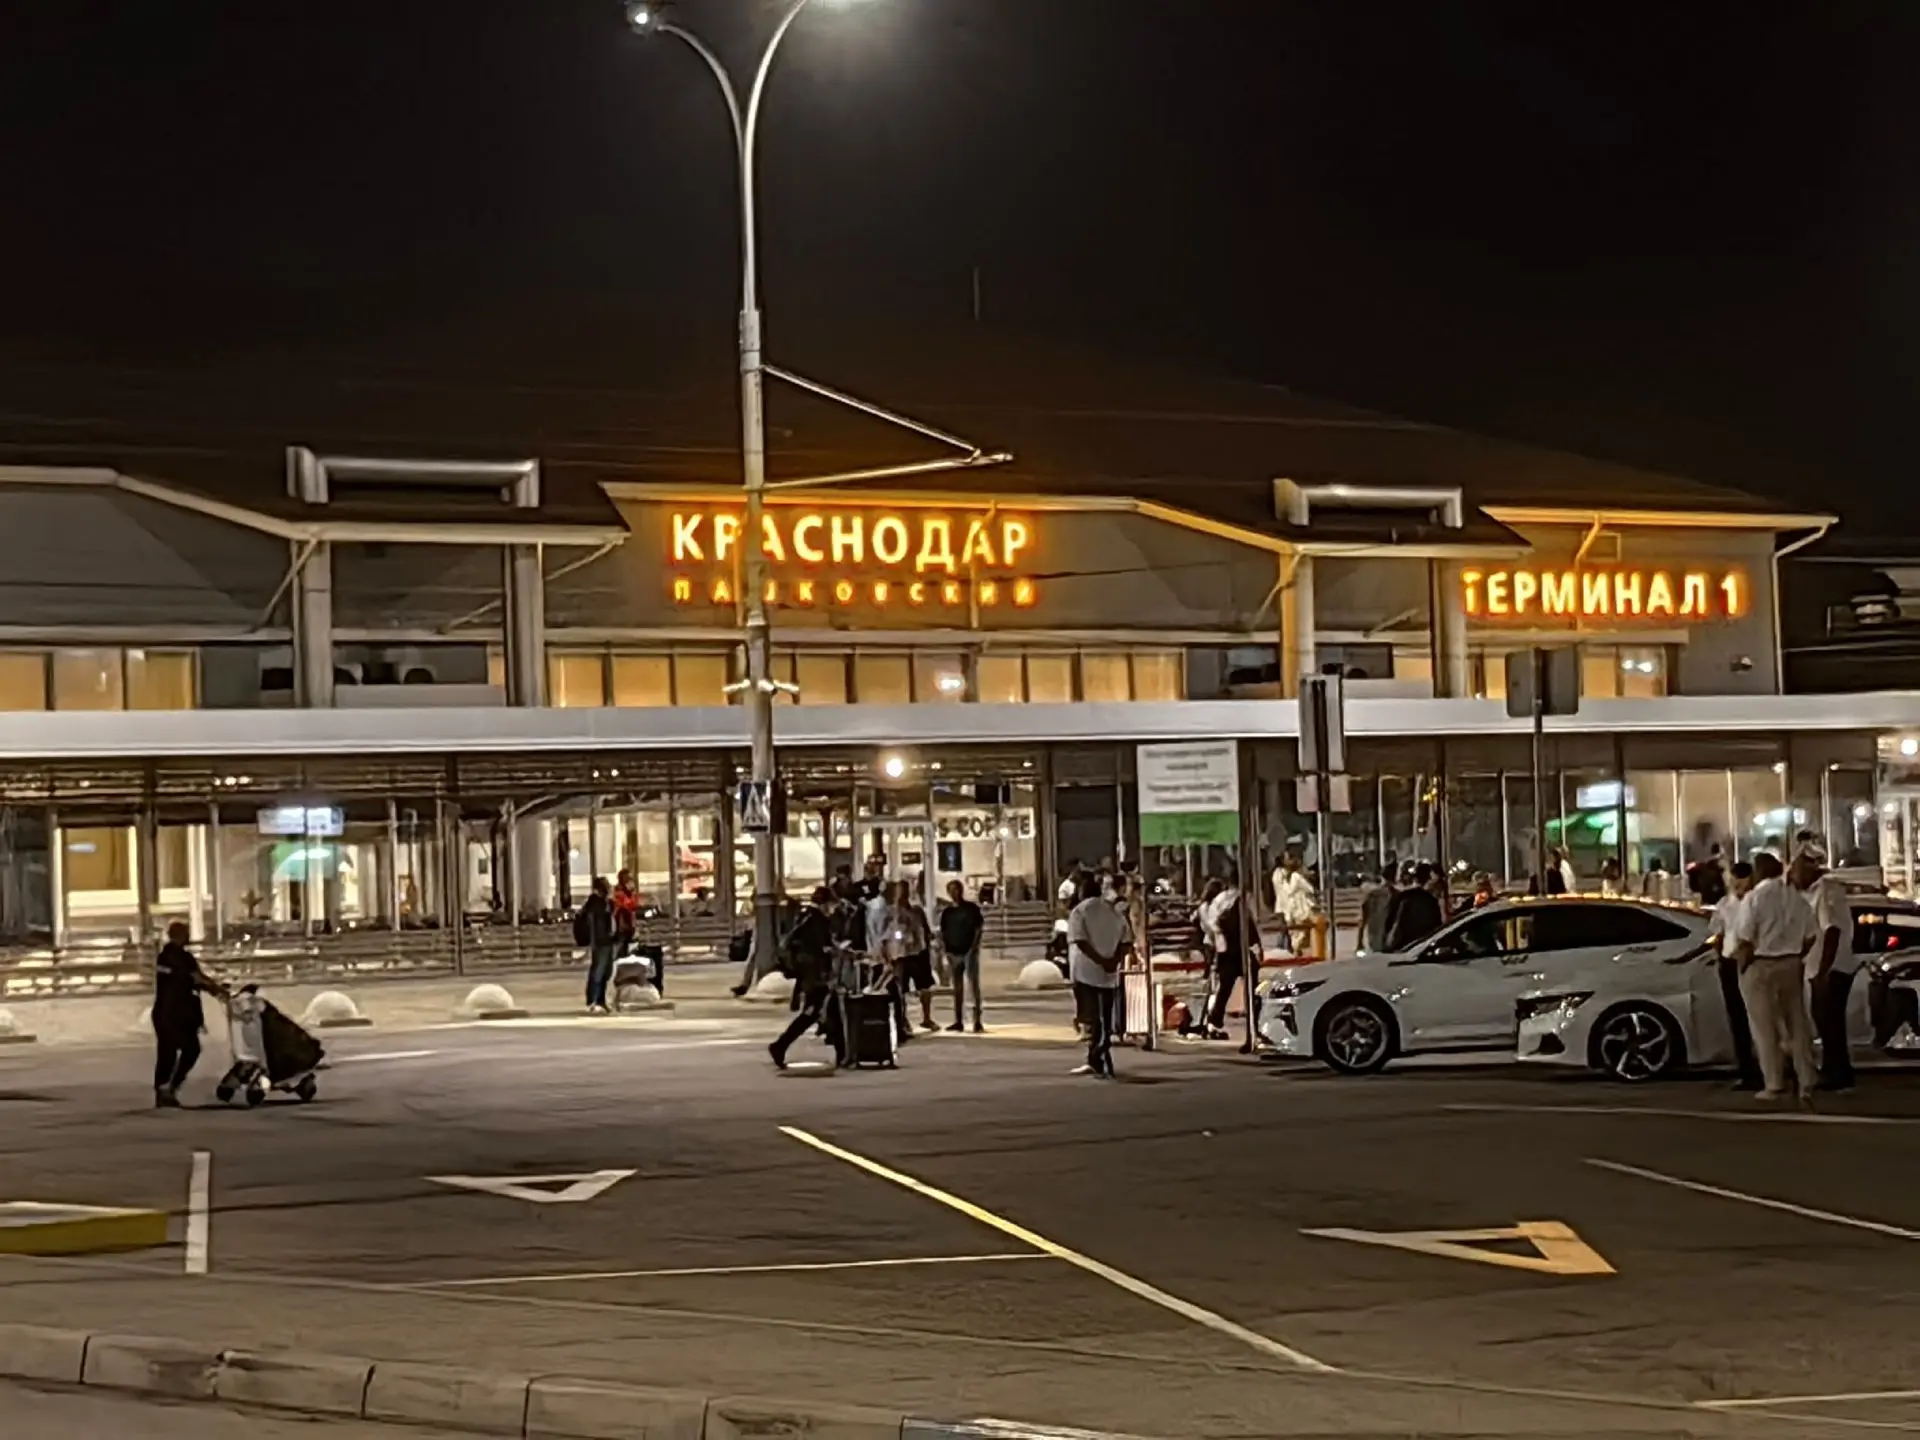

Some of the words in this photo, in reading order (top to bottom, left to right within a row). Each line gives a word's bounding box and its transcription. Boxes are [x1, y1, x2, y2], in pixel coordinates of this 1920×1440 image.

[672, 513, 1029, 574] КРАСНОДАР
[673, 577, 1035, 606] ПАКОВСКИЙ
[1462, 571, 1707, 615] ТЕРМИНАЛ
[1720, 573, 1741, 615] 1
